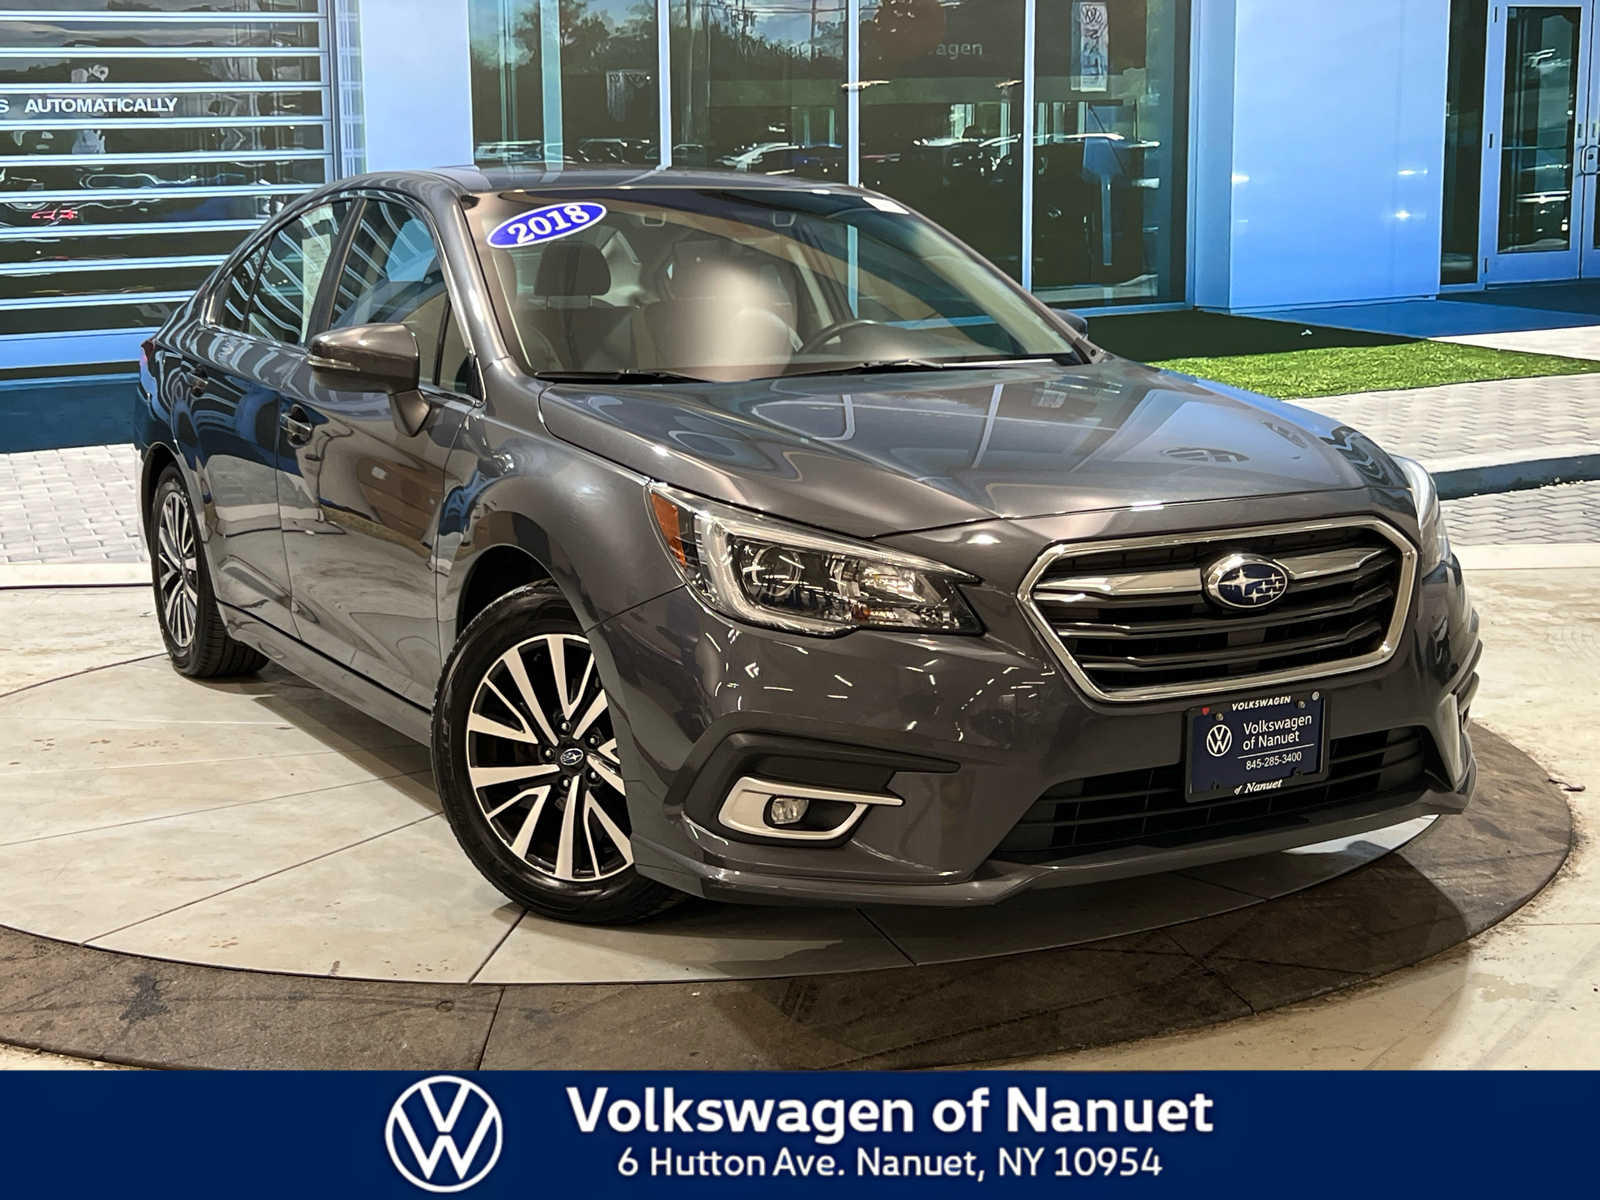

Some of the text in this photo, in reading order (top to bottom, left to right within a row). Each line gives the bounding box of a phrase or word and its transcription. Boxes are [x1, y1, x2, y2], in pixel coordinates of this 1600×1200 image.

[25, 97, 178, 113] AUTOMATICALLY
[507, 204, 590, 244] 2018
[1232, 696, 1291, 711] VOLKSWAGEN
[1243, 714, 1312, 735] Volkswagen
[1242, 731, 1300, 751] of Nanuet
[1246, 751, 1302, 770] 845-285-3400
[1234, 779, 1283, 796] of Nanuet
